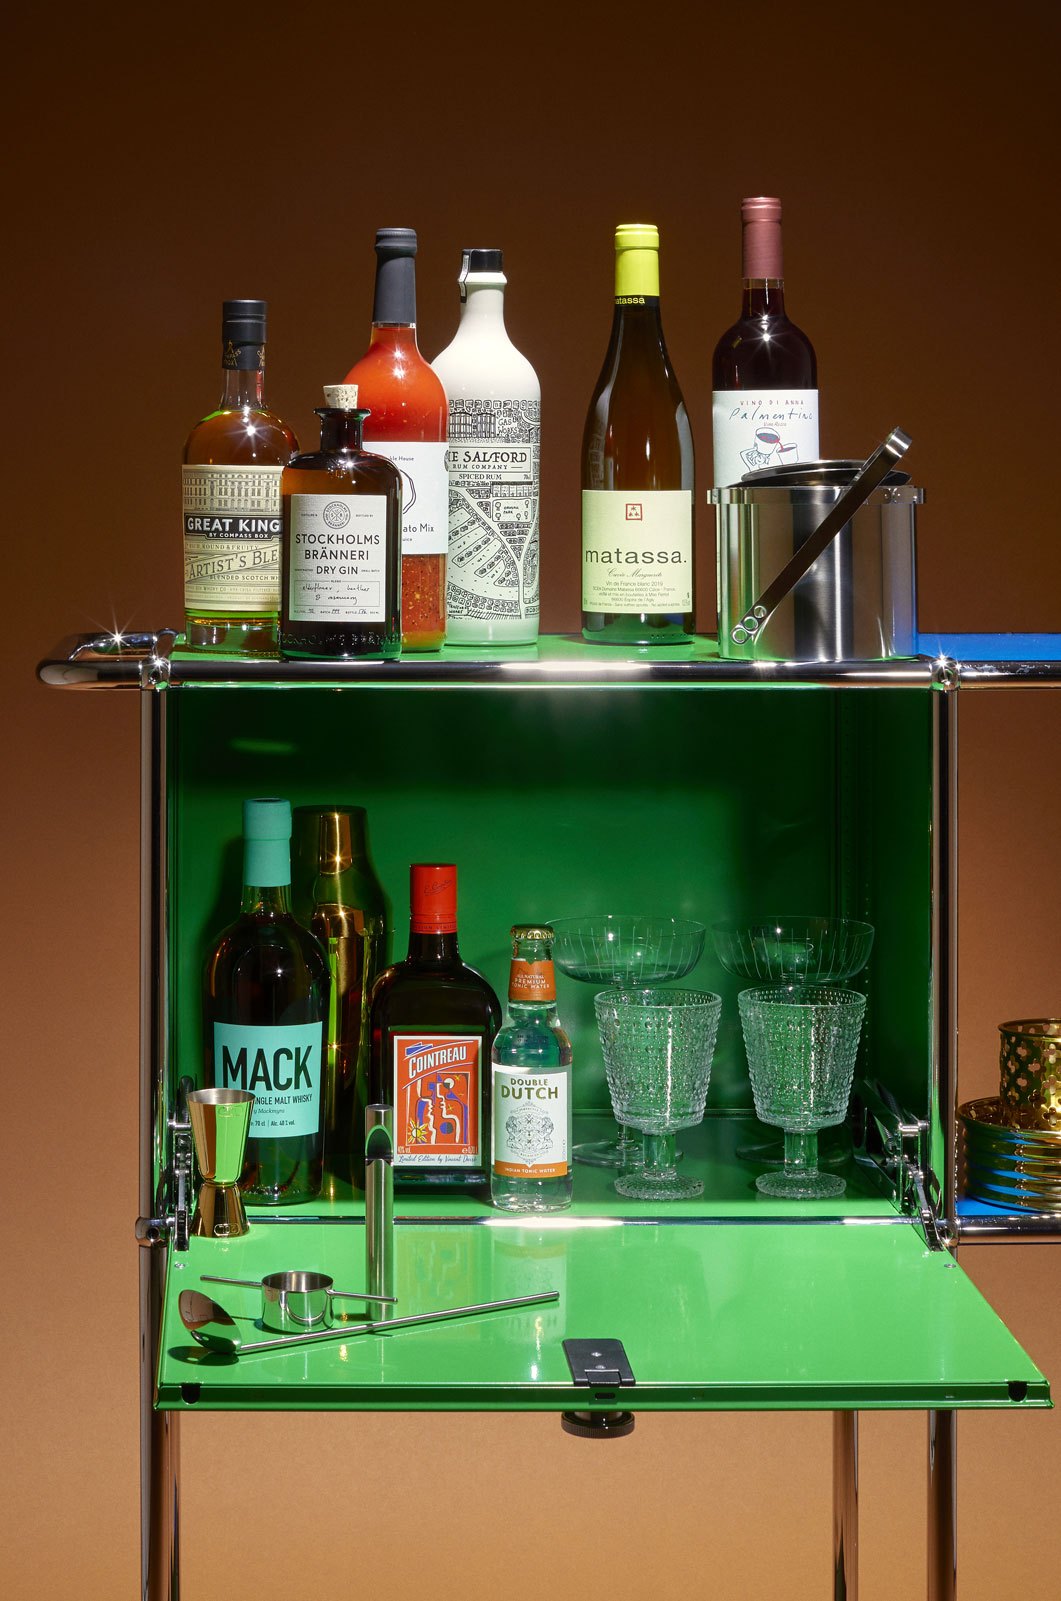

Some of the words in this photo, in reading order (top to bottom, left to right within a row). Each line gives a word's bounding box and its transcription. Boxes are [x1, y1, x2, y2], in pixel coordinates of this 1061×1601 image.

[463, 451, 527, 463] SALFORD
[187, 517, 233, 532] GREAT
[238, 520, 280, 532] KING
[420, 523, 434, 532] Mix
[295, 534, 380, 545] STOCKHOLMS
[304, 546, 369, 560] BRÄNNERI
[585, 548, 687, 564] matassa.
[189, 553, 247, 579] ARTIST'S
[316, 566, 336, 574] DRY
[339, 566, 358, 575] GIN
[222, 1044, 313, 1091] MACK
[408, 1046, 467, 1079] COINTREAU
[510, 1077, 548, 1086] DOUBLE
[274, 1096, 291, 1104] MALT
[292, 1093, 313, 1104] WHISKY
[501, 1084, 558, 1100] DUTCH
